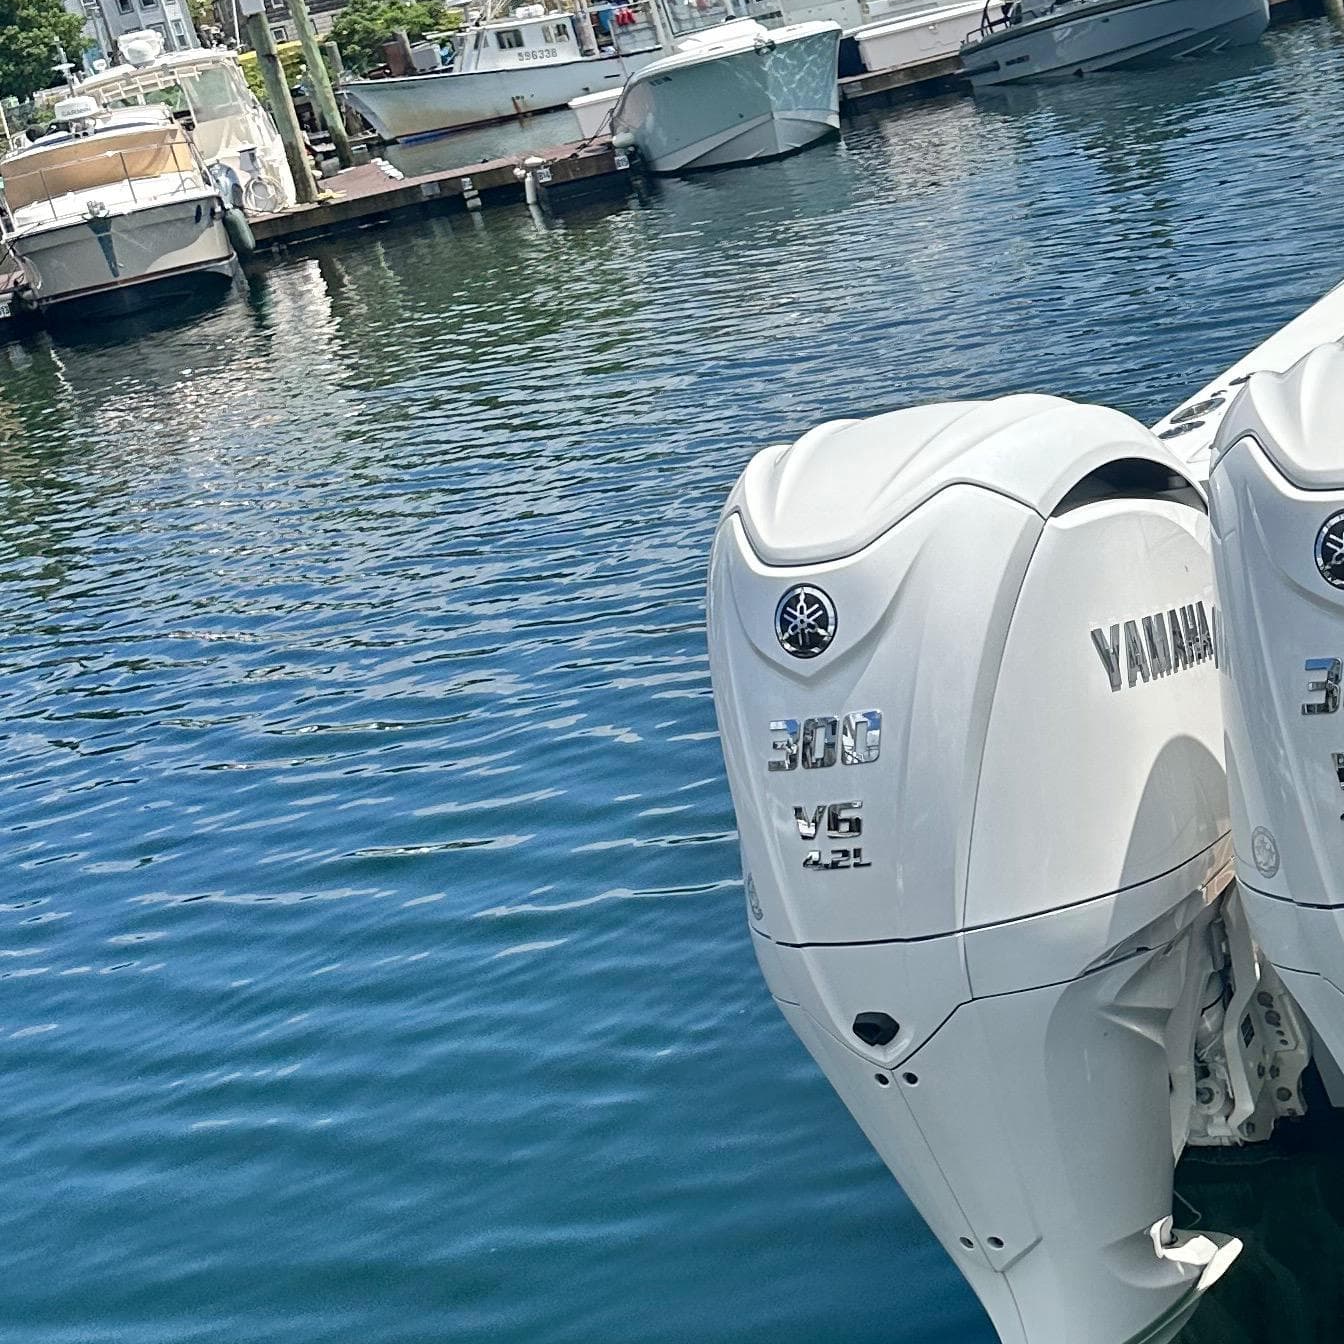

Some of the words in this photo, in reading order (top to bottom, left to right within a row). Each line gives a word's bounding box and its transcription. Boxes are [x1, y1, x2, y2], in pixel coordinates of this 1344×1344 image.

[1090, 601, 1214, 692] YAMAHA
[768, 708, 882, 772] 300
[794, 800, 863, 840] V6
[802, 847, 873, 871] 4.2L
